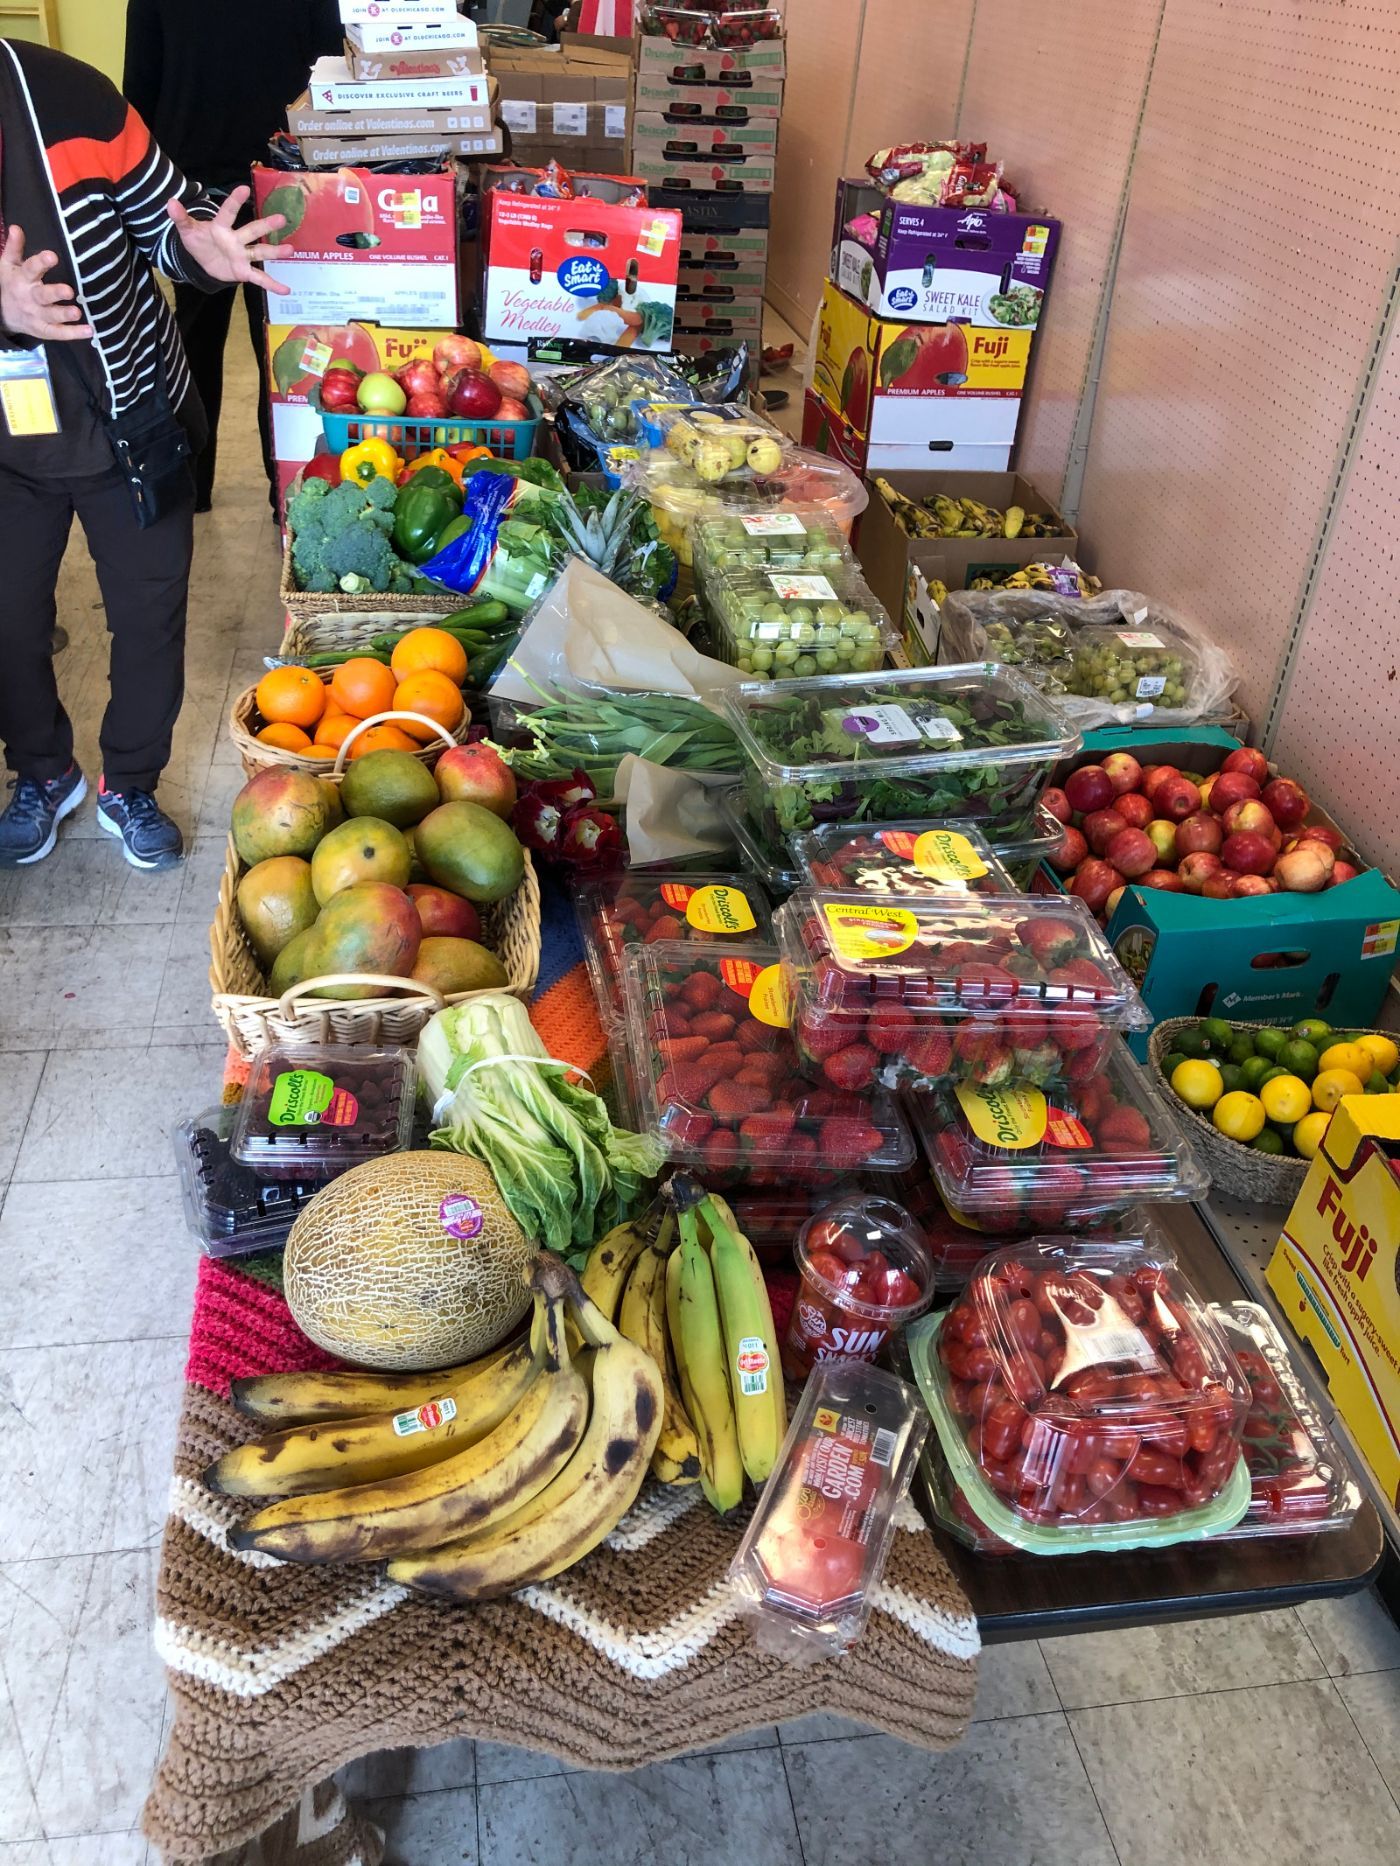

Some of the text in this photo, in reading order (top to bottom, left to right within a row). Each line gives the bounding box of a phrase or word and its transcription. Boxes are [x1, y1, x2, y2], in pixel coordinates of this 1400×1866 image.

[297, 117, 434, 131] Order online at Valentinos.com
[313, 149, 338, 161] Order
[339, 146, 369, 159] online
[370, 146, 380, 157] at
[377, 189, 438, 213] Gla
[899, 216, 925, 226] SERVES 4
[323, 252, 354, 261] APPLES
[571, 260, 593, 274] Eat
[564, 272, 601, 287] Smart
[500, 289, 576, 315] Vegetable
[923, 304, 979, 316] SALAD KIT
[925, 290, 981, 307] SWEET KALE
[500, 309, 562, 338] Medley
[974, 336, 1010, 359] Fuji
[888, 388, 919, 396] PREMIUM
[935, 834, 971, 877] Driscoll's
[713, 888, 740, 930] Driscoll's
[827, 905, 904, 917] Central West
[1243, 993, 1281, 1002] Member's
[280, 1073, 305, 1123] Driscoll's
[1316, 1174, 1378, 1282] Fuji
[1283, 1248, 1297, 1273] Sweet
[1322, 1243, 1338, 1269] Crisp
[1338, 1269, 1351, 1293] with
[1355, 1299, 1398, 1368] sugary-sweet
[1322, 1256, 1380, 1358] like fresh apple juice.
[821, 1327, 888, 1353] SUN
[1339, 1346, 1350, 1366] Tart
[822, 1442, 853, 1499] GARDEN
[844, 1464, 865, 1500] .COM
